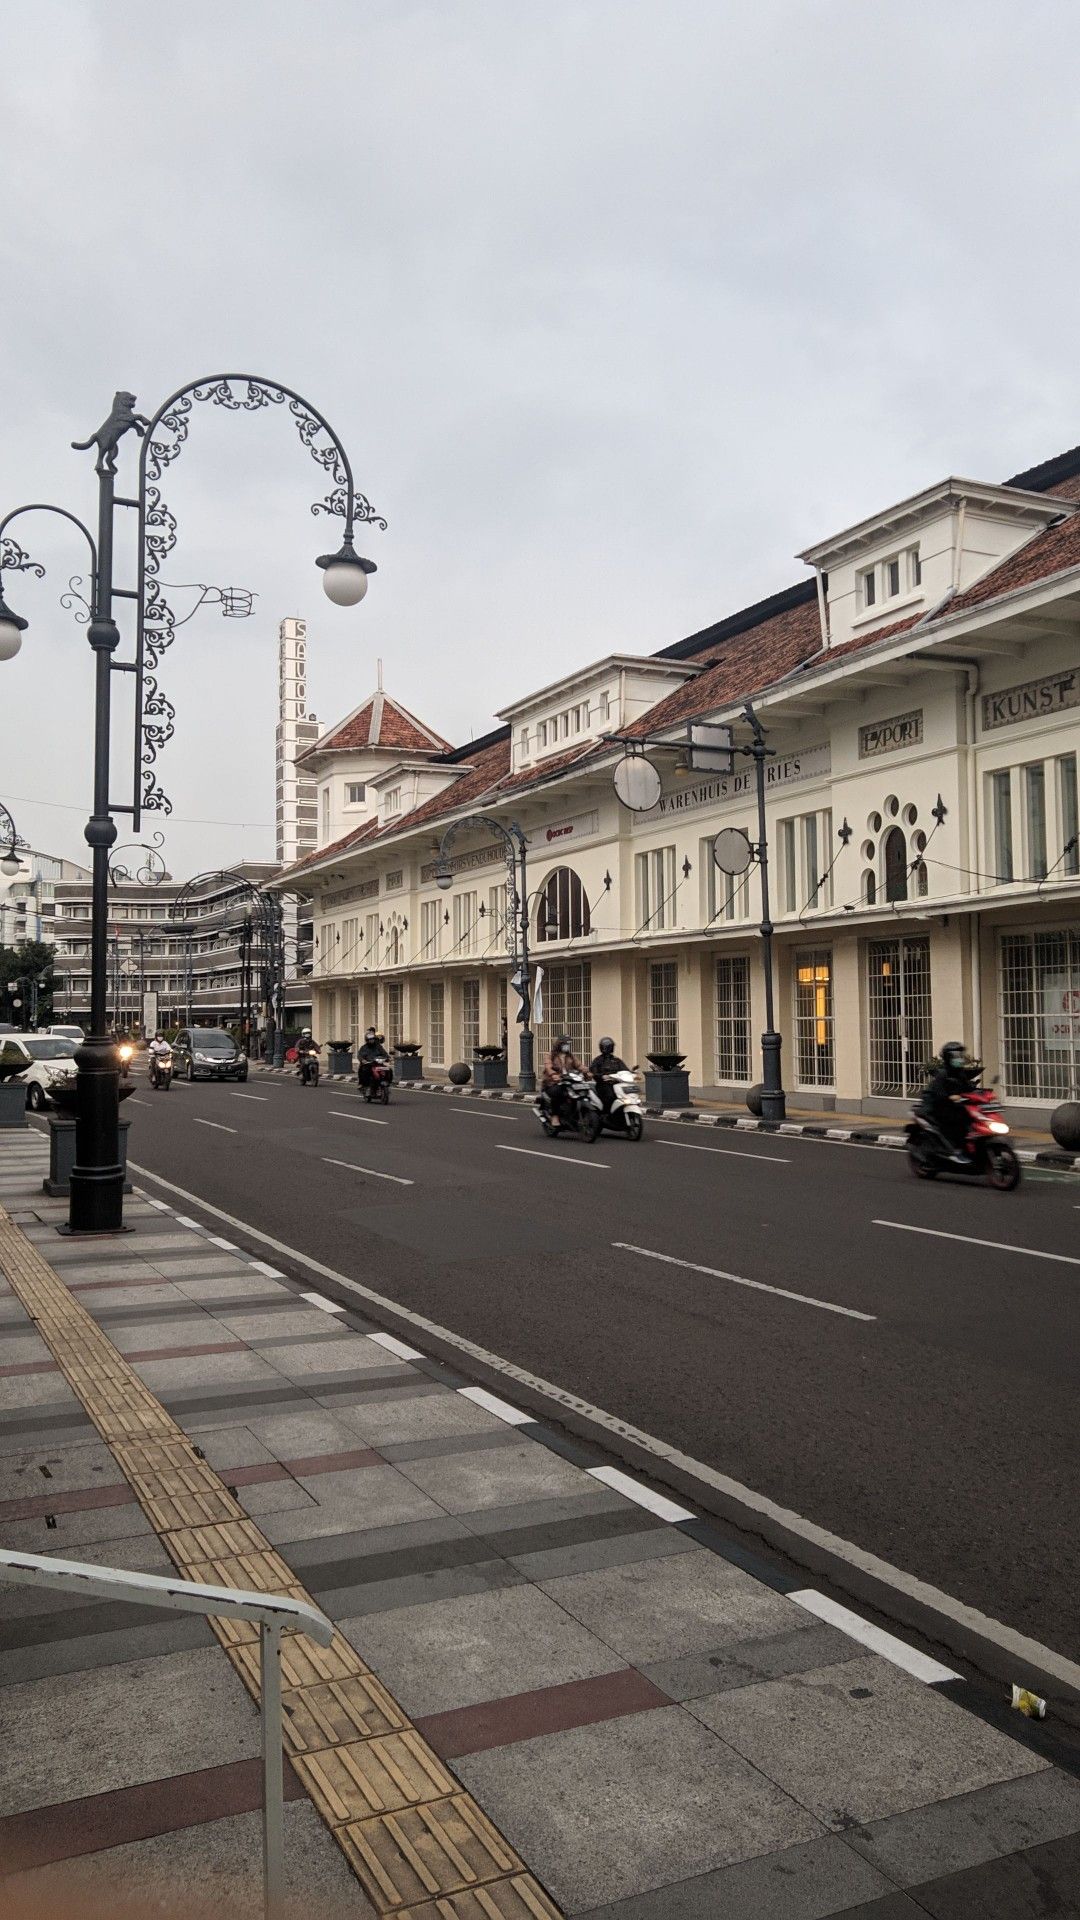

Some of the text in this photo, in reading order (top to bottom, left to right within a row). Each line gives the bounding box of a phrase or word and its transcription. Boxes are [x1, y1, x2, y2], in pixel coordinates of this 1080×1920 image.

[993, 679, 1072, 722] KUNST
[864, 718, 920, 752] EXPORT
[659, 759, 801, 812] WARENHUIS DE RIES
